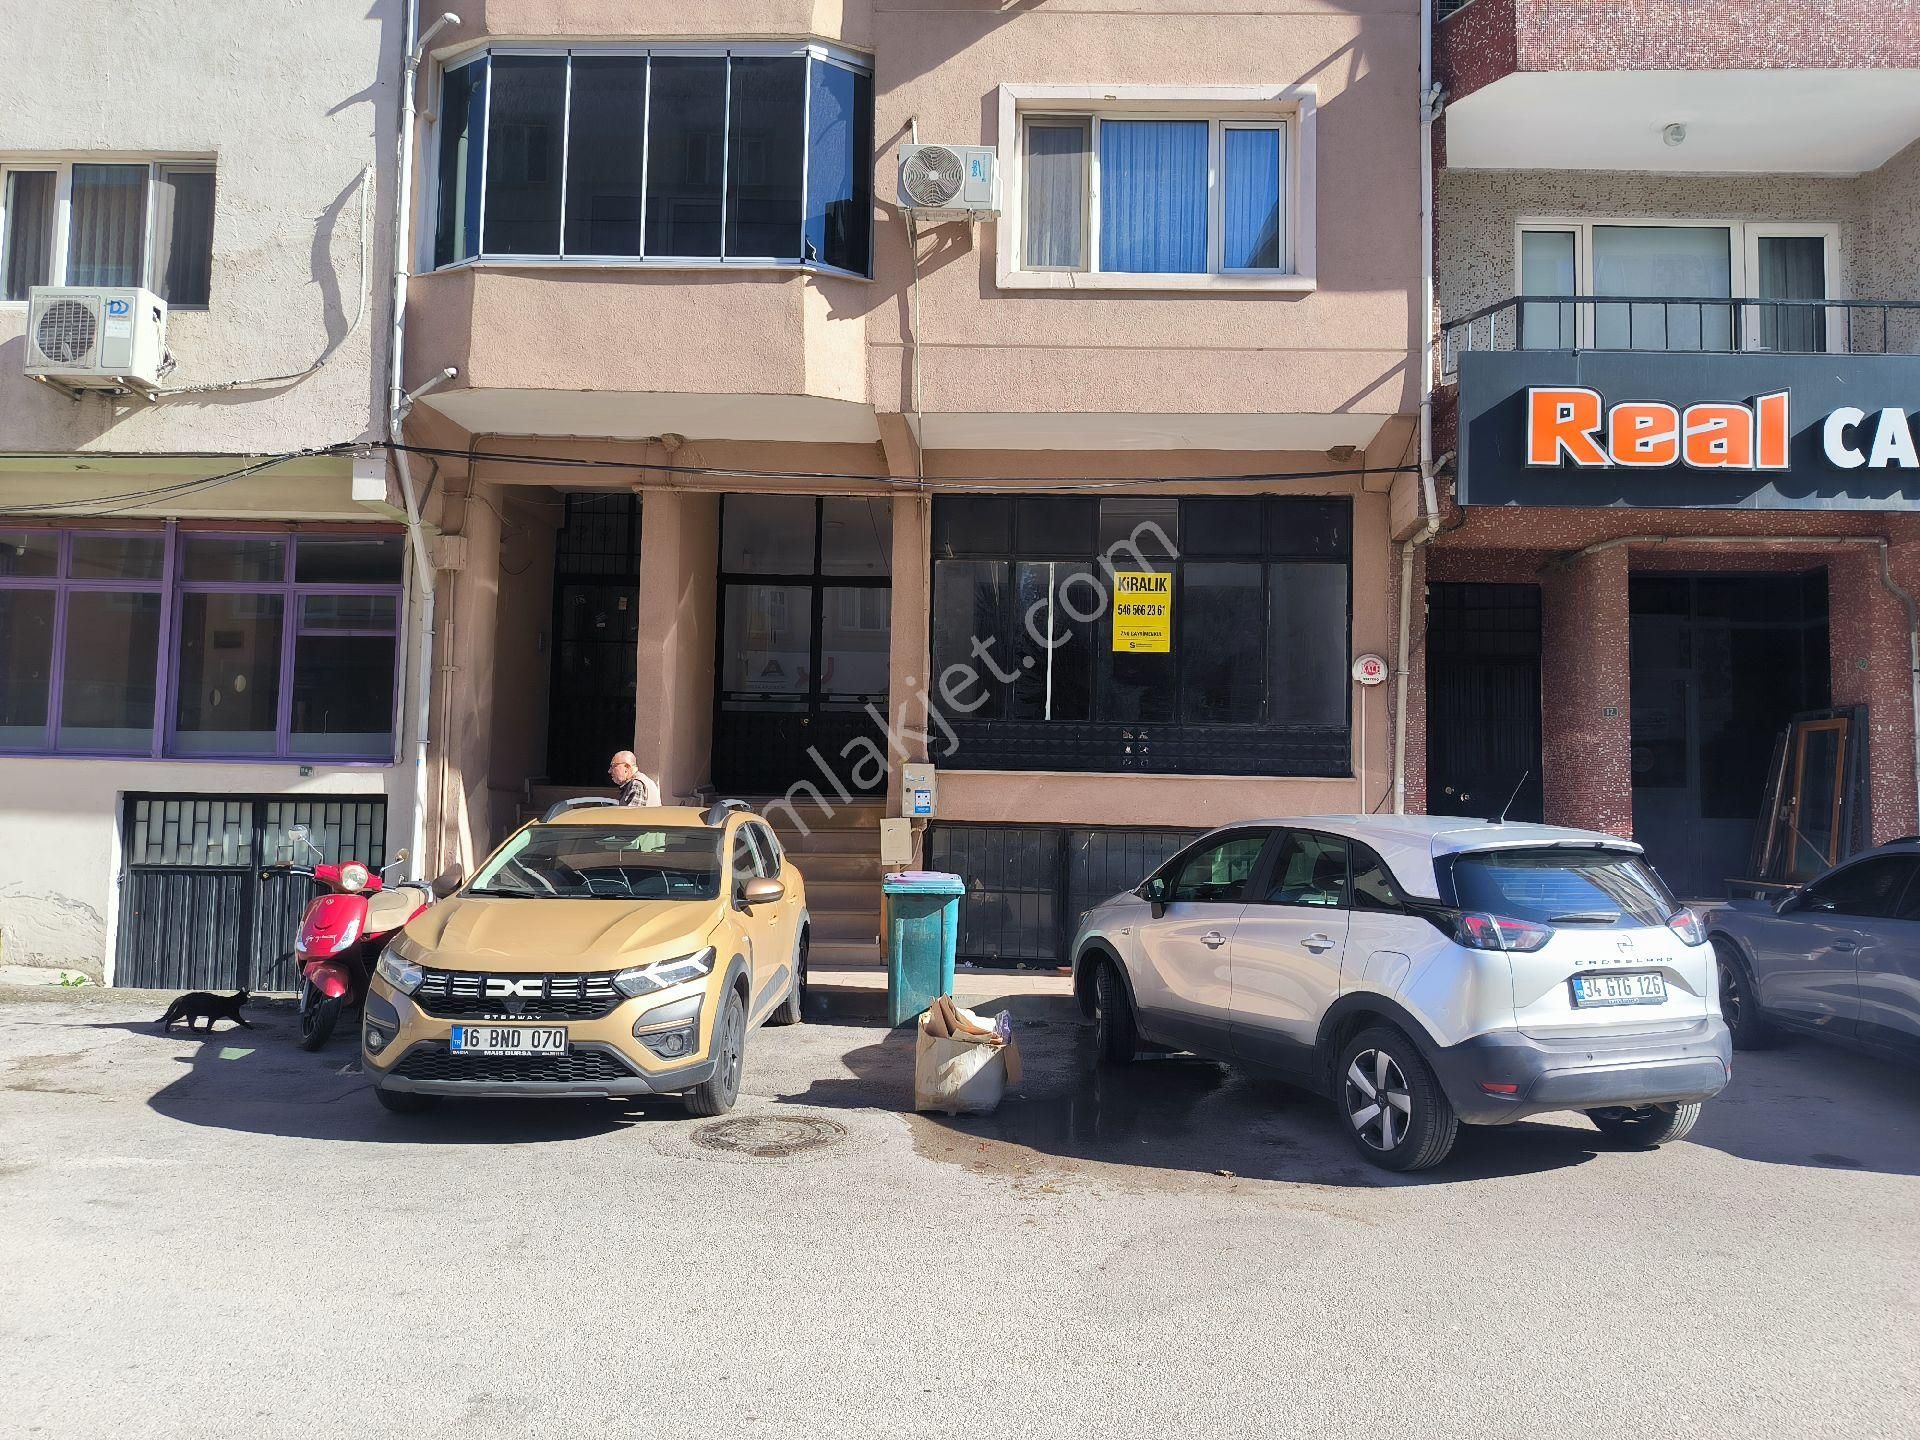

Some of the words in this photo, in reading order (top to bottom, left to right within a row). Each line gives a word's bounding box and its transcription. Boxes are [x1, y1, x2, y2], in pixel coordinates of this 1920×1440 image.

[1526, 386, 1790, 470] Real
[1822, 406, 1920, 469] CA
[1118, 604, 1131, 615] 546
[1147, 605, 1156, 615] 23
[1584, 978, 1602, 998] 34
[1606, 977, 1632, 997] GTG
[1637, 975, 1661, 995] 126
[463, 1028, 480, 1048] 16
[489, 1029, 521, 1048] BND
[531, 1030, 563, 1049] 070
